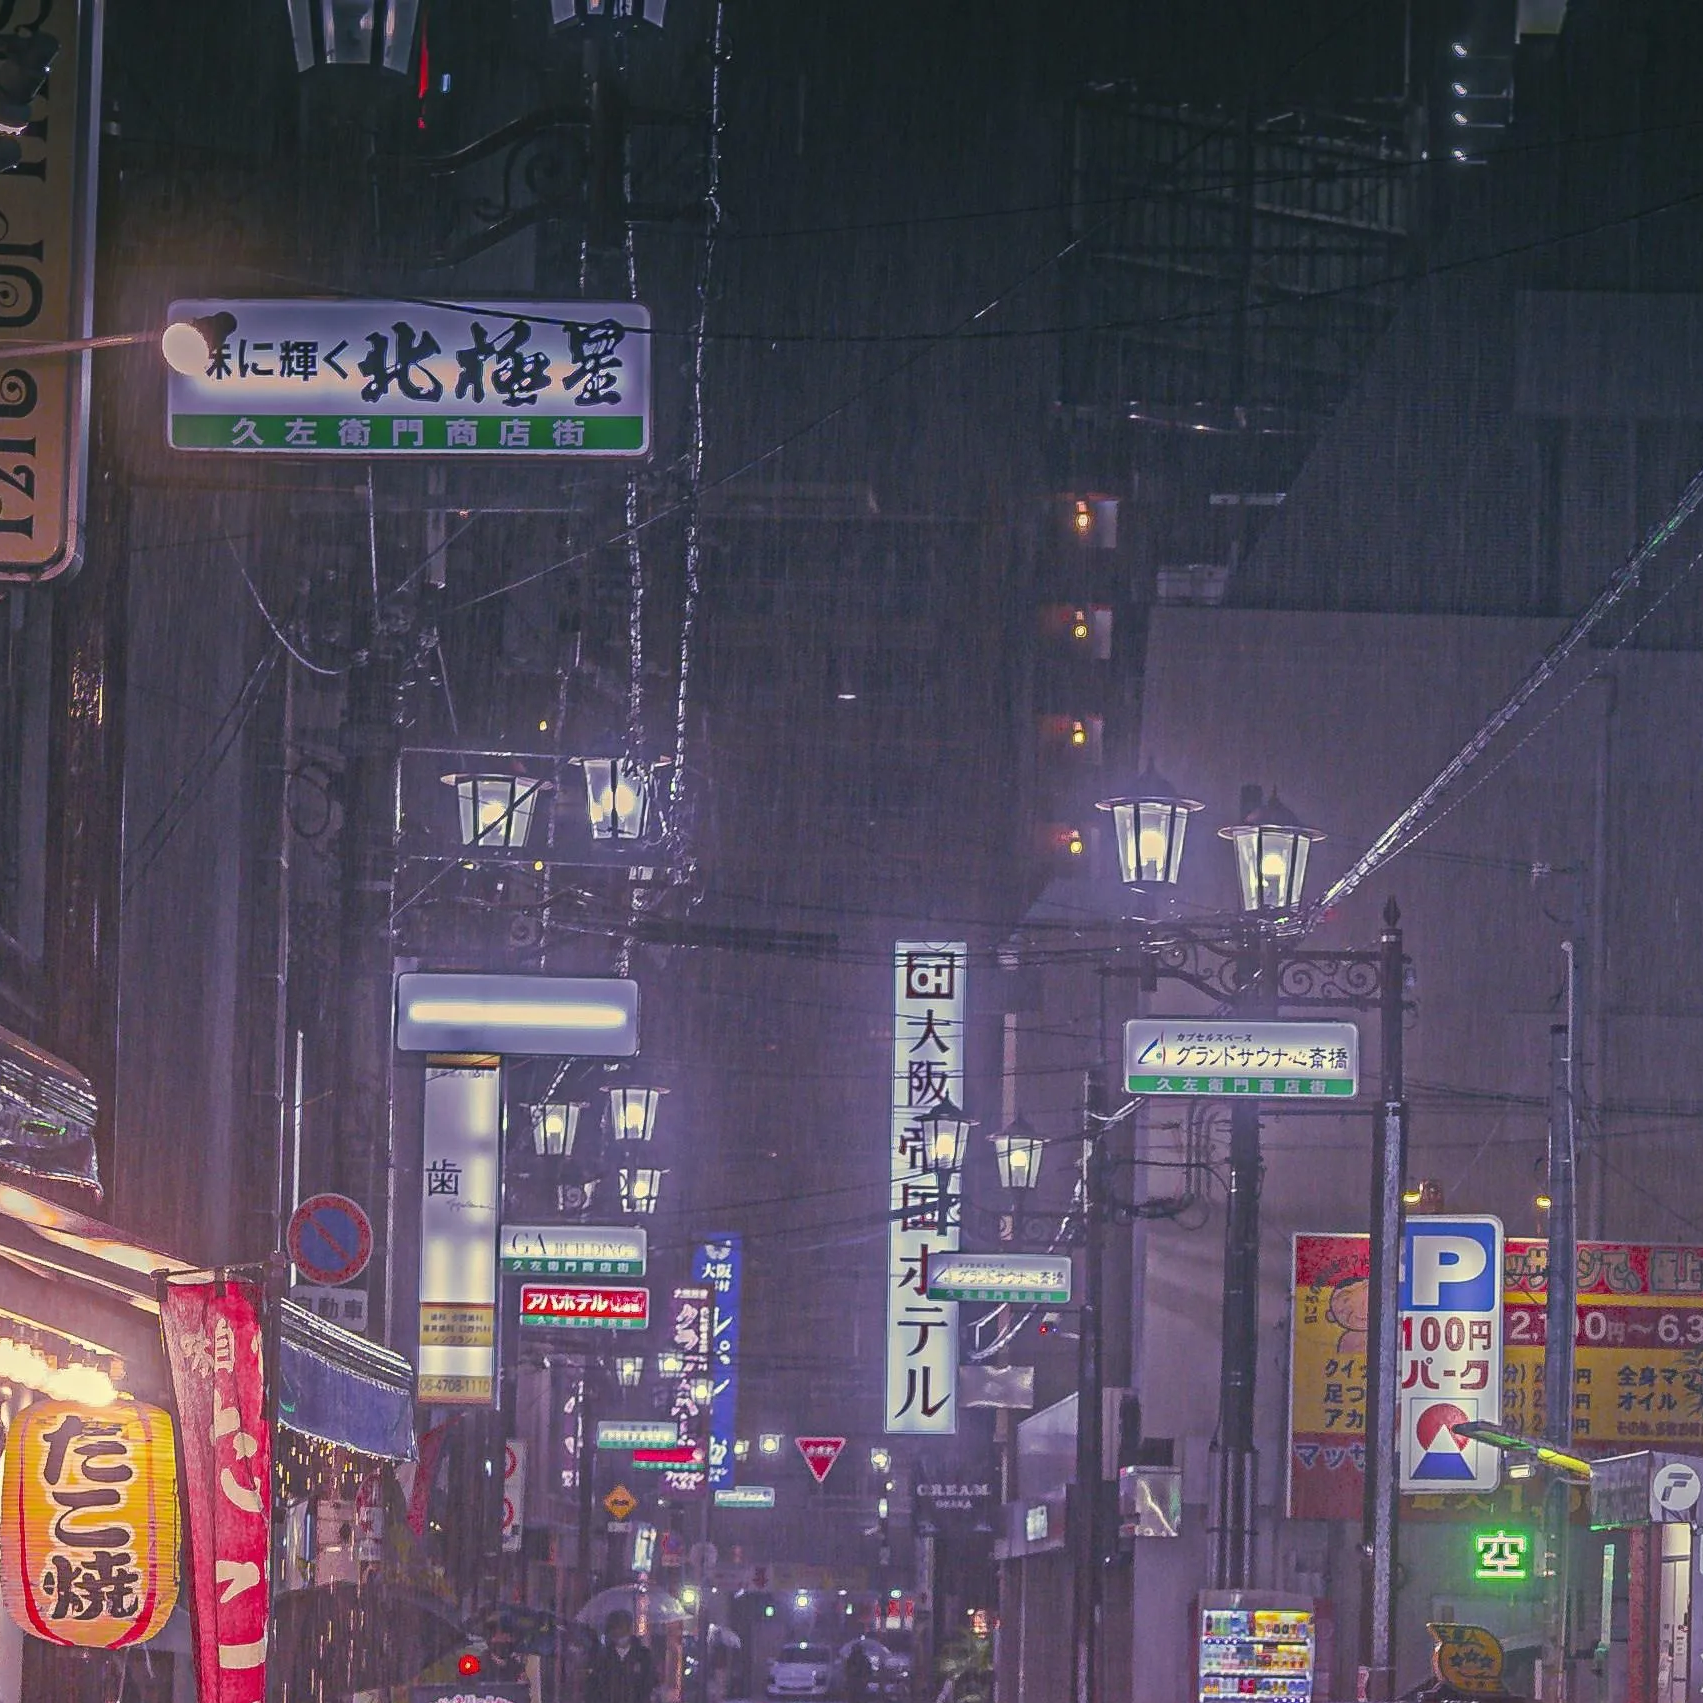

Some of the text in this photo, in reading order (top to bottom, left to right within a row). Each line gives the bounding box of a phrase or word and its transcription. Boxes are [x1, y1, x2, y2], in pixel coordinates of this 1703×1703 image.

[231, 416, 587, 449] 久左衛門商店街
[1176, 1044, 1349, 1071] グランドサウナ心斎橋
[1155, 1077, 1329, 1095] 久左衛門商店街
[426, 1158, 462, 1196] 歯
[1413, 1236, 1486, 1306] P
[527, 1293, 609, 1313] アパホテル
[1402, 1316, 1492, 1351] 100円
[1401, 1356, 1490, 1390] パーク
[40, 1414, 139, 1621] たこ焼
[1476, 1531, 1527, 1579] 空
